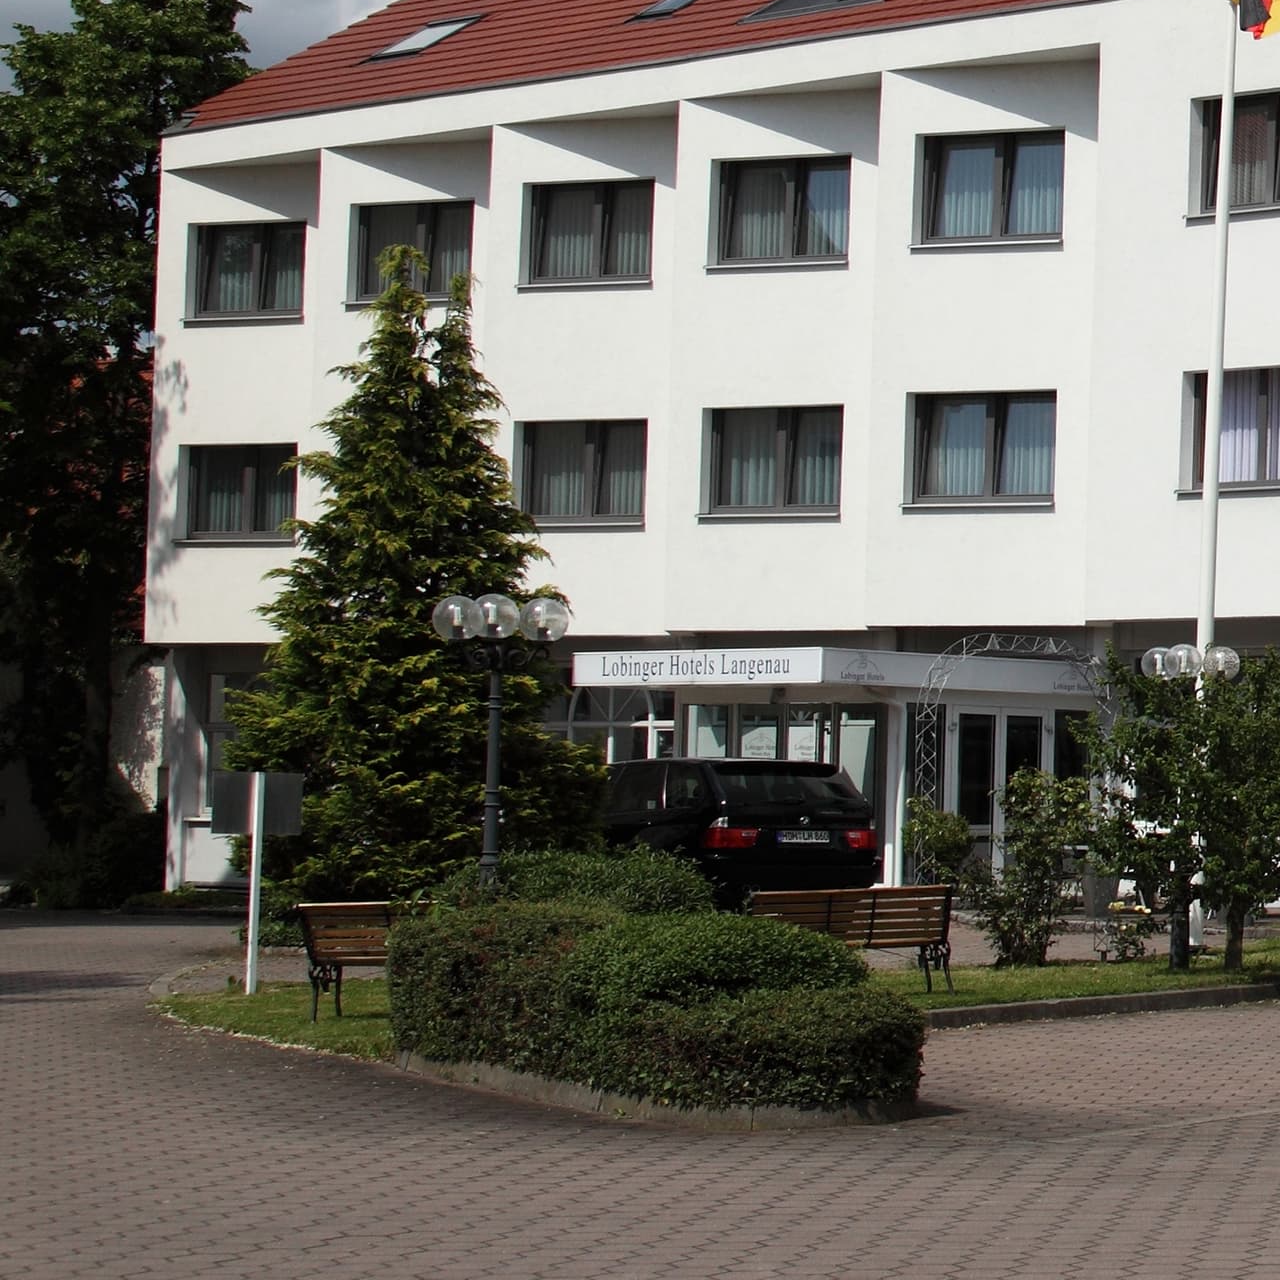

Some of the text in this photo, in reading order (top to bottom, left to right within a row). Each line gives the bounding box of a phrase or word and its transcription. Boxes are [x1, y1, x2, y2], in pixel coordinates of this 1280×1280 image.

[602, 654, 791, 682] Lobinger Hotels Langenau
